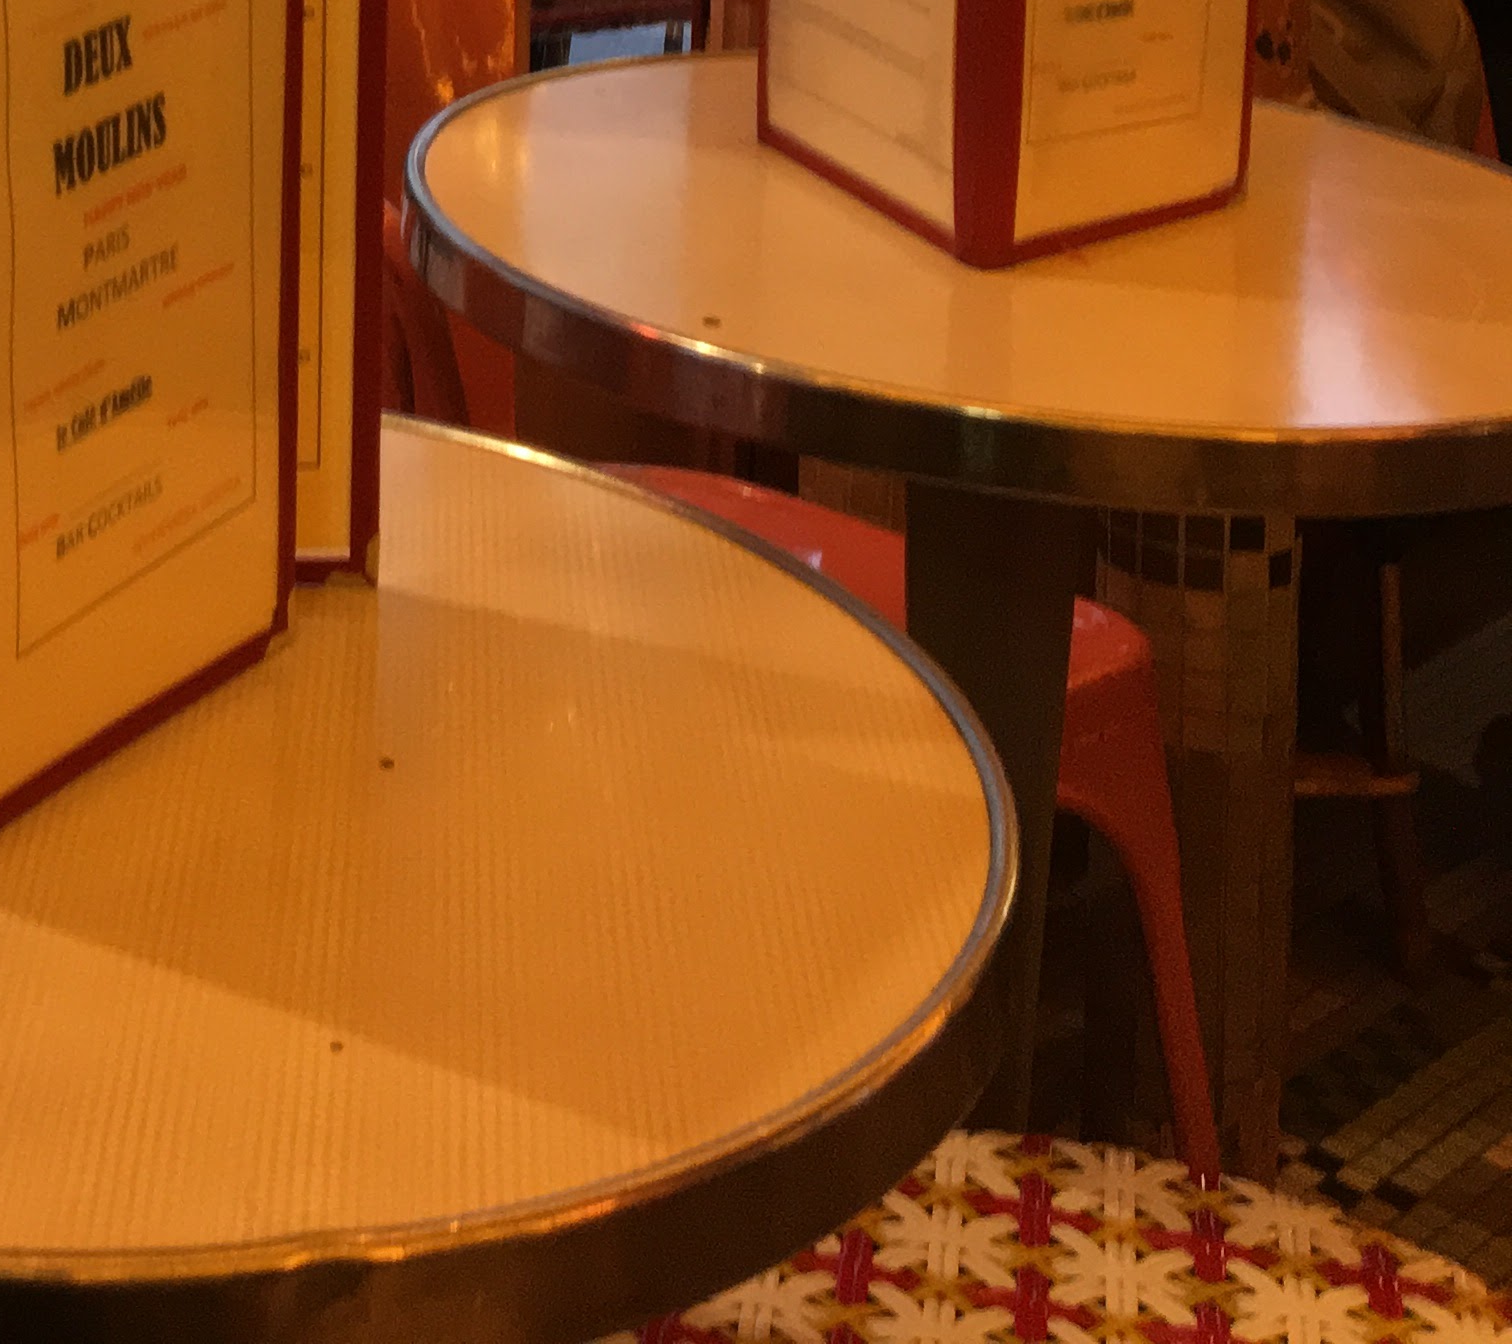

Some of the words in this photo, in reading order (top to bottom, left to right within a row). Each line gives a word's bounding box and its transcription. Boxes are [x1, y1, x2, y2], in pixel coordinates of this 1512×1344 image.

[62, 14, 133, 98] DEUX
[52, 90, 167, 199] MOULINS
[57, 240, 178, 331] MONTMARTRE
[83, 222, 130, 272] PARIS
